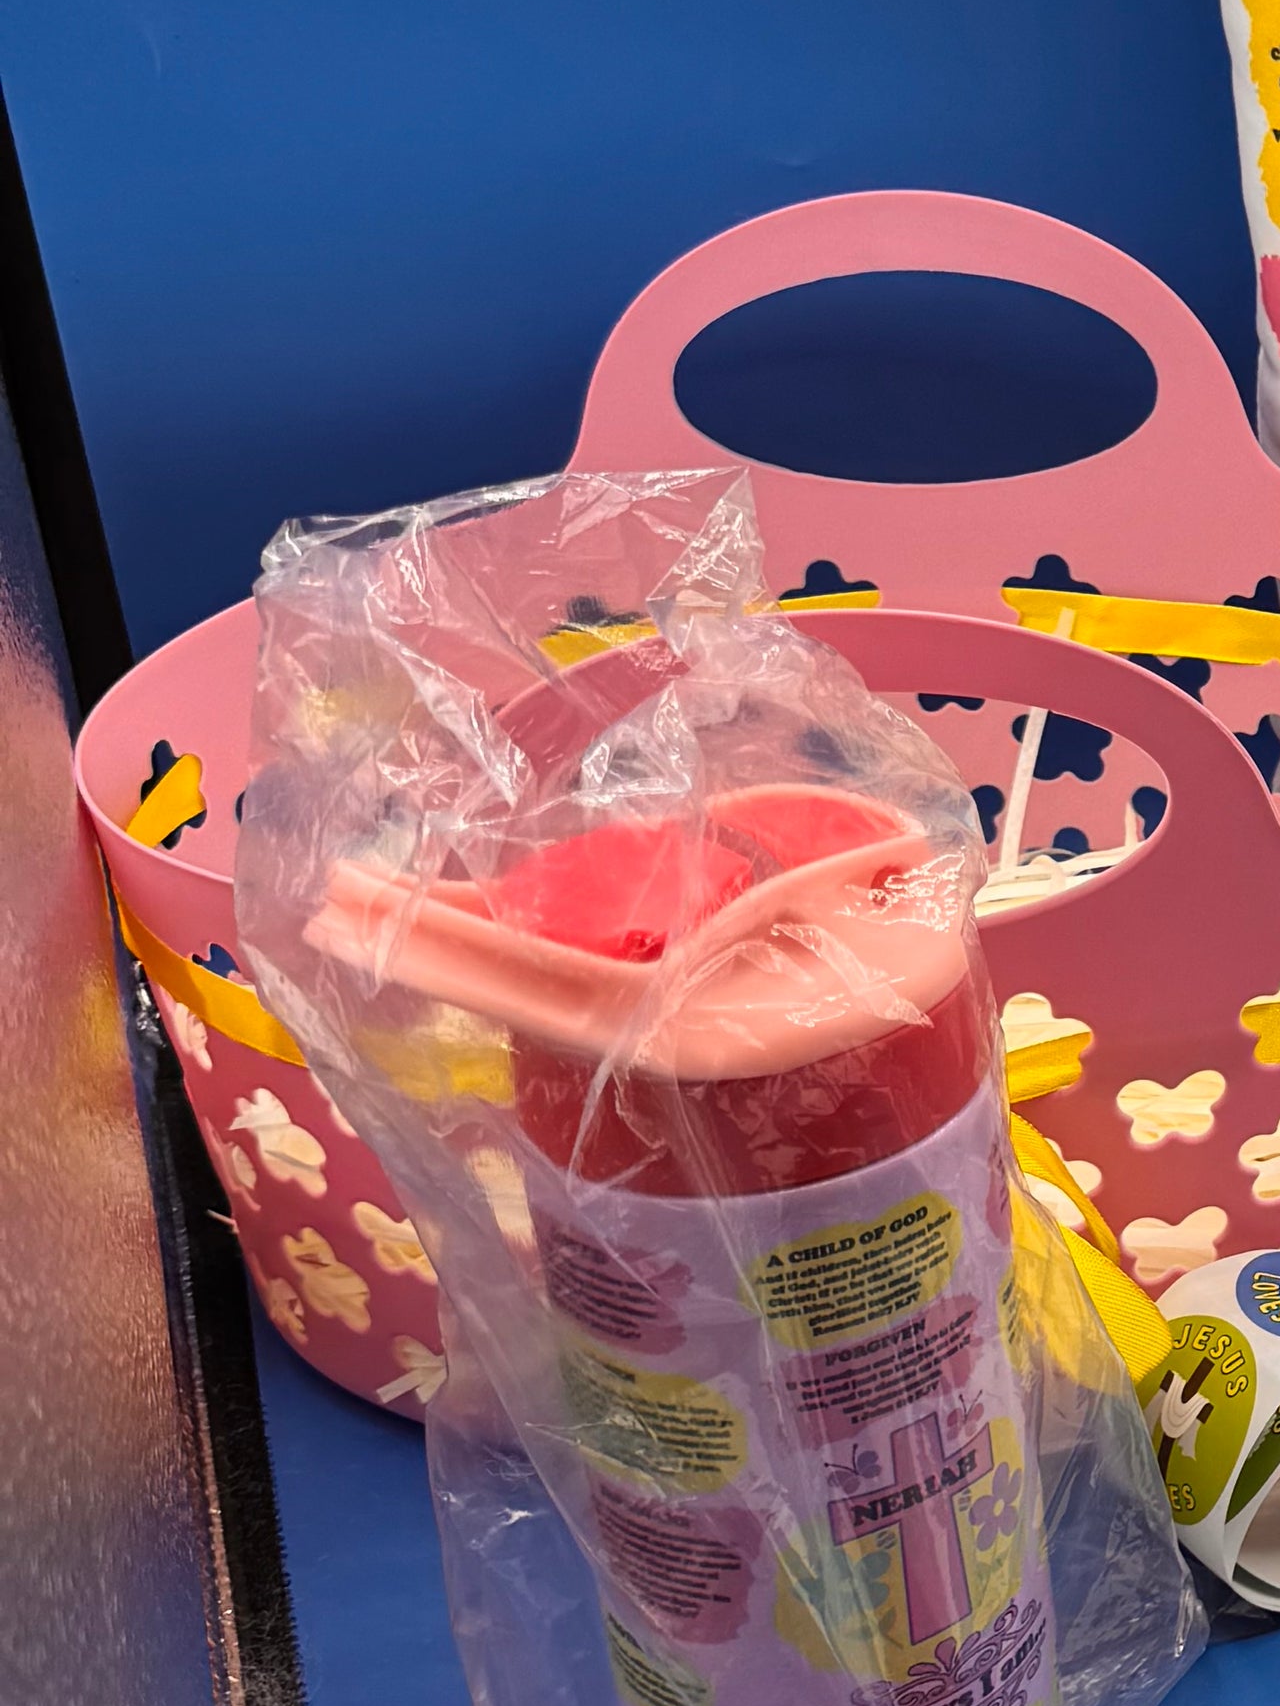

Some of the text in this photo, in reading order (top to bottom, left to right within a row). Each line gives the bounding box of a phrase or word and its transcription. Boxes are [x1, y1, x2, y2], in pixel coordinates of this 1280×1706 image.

[767, 1206, 928, 1268] A CHILD OF GOD
[825, 1319, 926, 1366] FORGIVEN
[1172, 1323, 1250, 1399] JESUS
[980, 1671, 995, 1698] I
